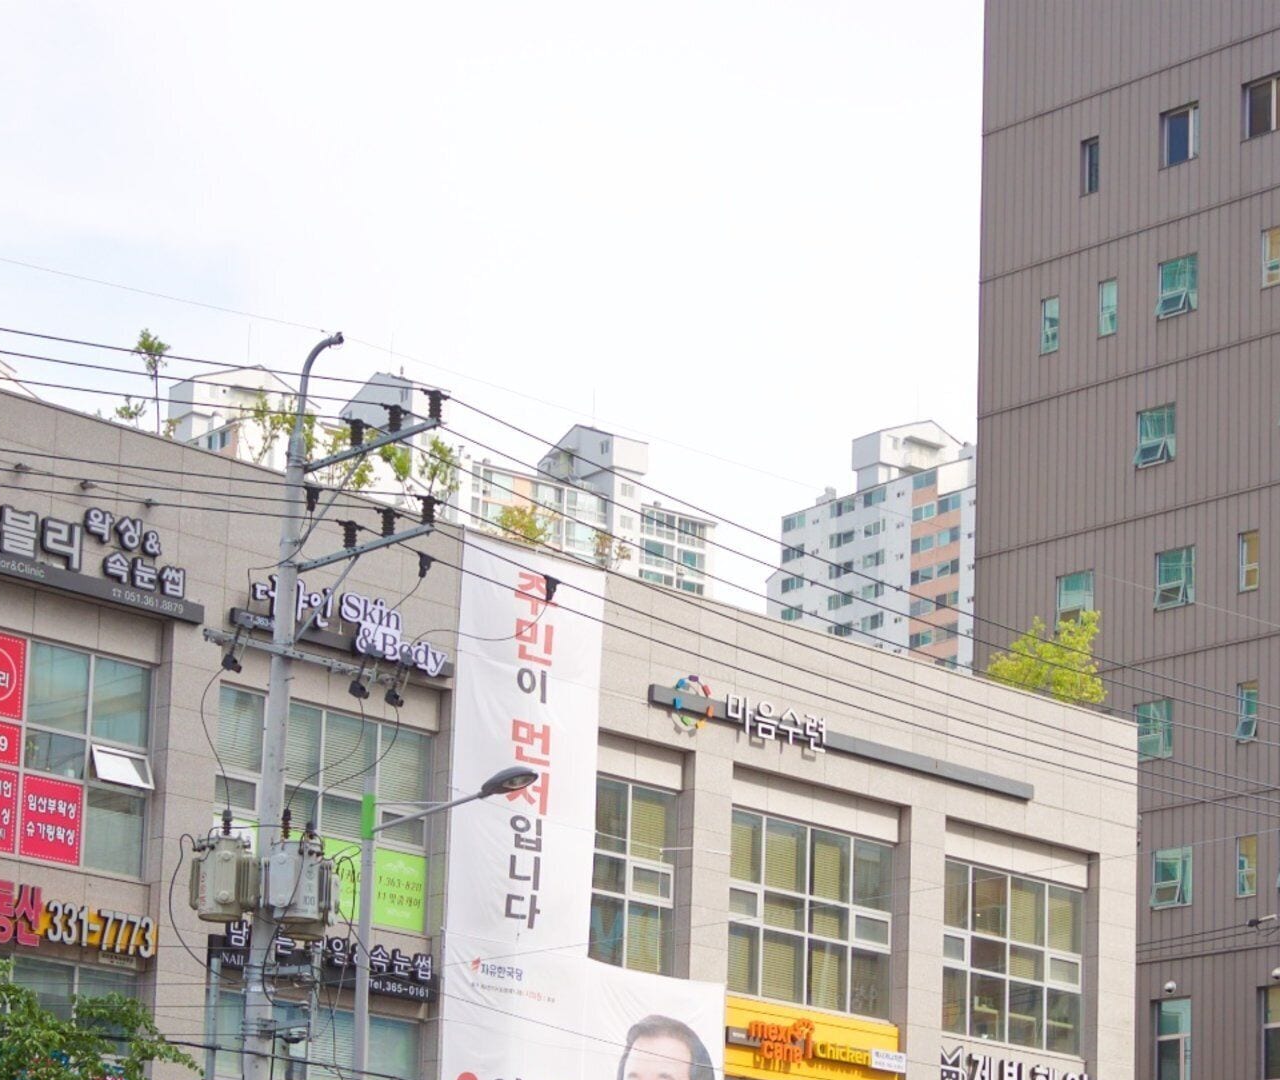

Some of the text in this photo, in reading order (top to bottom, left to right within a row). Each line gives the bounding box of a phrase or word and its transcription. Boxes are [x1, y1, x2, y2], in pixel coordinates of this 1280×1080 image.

[103, 553, 185, 598] 속눈썹
[123, 589, 184, 615] 051.361.8879
[340, 592, 402, 631] Skin
[514, 571, 558, 705] 주민이
[726, 692, 827, 752] 마음수련
[27, 794, 77, 819] 임산부왁싱
[504, 718, 552, 930] 먼저입니다
[25, 820, 76, 846] 슈가링왁싱
[46, 899, 157, 959] 331-7773
[481, 963, 524, 981] 자유한국당
